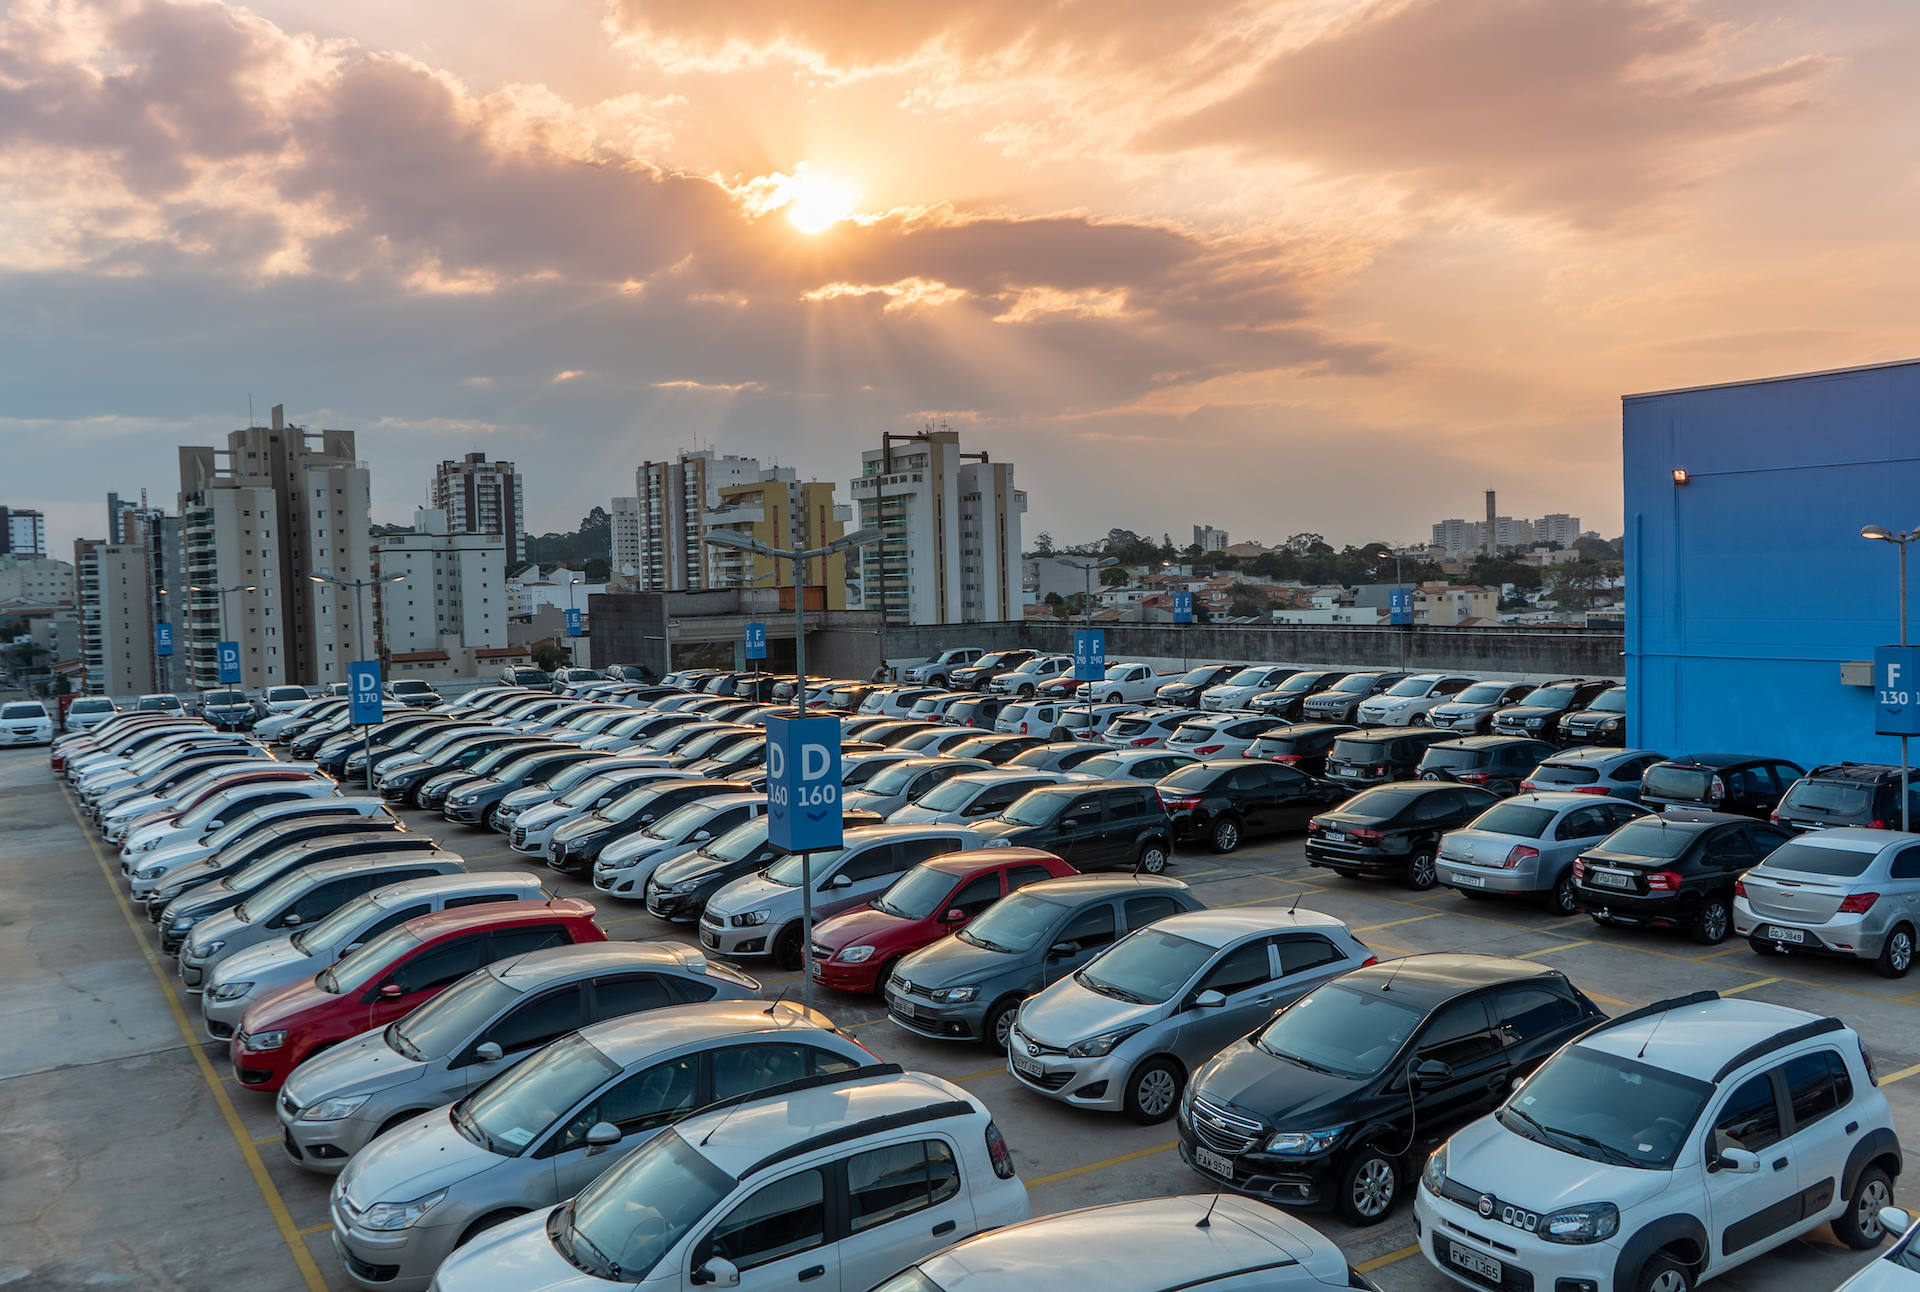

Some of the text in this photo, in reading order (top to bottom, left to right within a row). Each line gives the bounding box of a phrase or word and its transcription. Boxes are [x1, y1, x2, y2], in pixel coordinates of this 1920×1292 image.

[1175, 598, 1179, 607] F
[1185, 598, 1189, 607] F
[1392, 596, 1397, 606] F
[1404, 595, 1409, 606] F
[572, 614, 578, 622] E
[161, 630, 169, 639] E
[756, 630, 761, 640] F
[1078, 640, 1084, 654] F
[1093, 640, 1099, 654] F
[224, 650, 236, 662] D
[1090, 656, 1103, 664] 140
[359, 673, 376, 691] D
[1888, 664, 1901, 688] F
[358, 693, 378, 703] 170
[1880, 691, 1908, 705] 130
[770, 742, 785, 779] D
[802, 744, 831, 781] D
[770, 783, 788, 806] 160
[798, 784, 836, 806] 160
